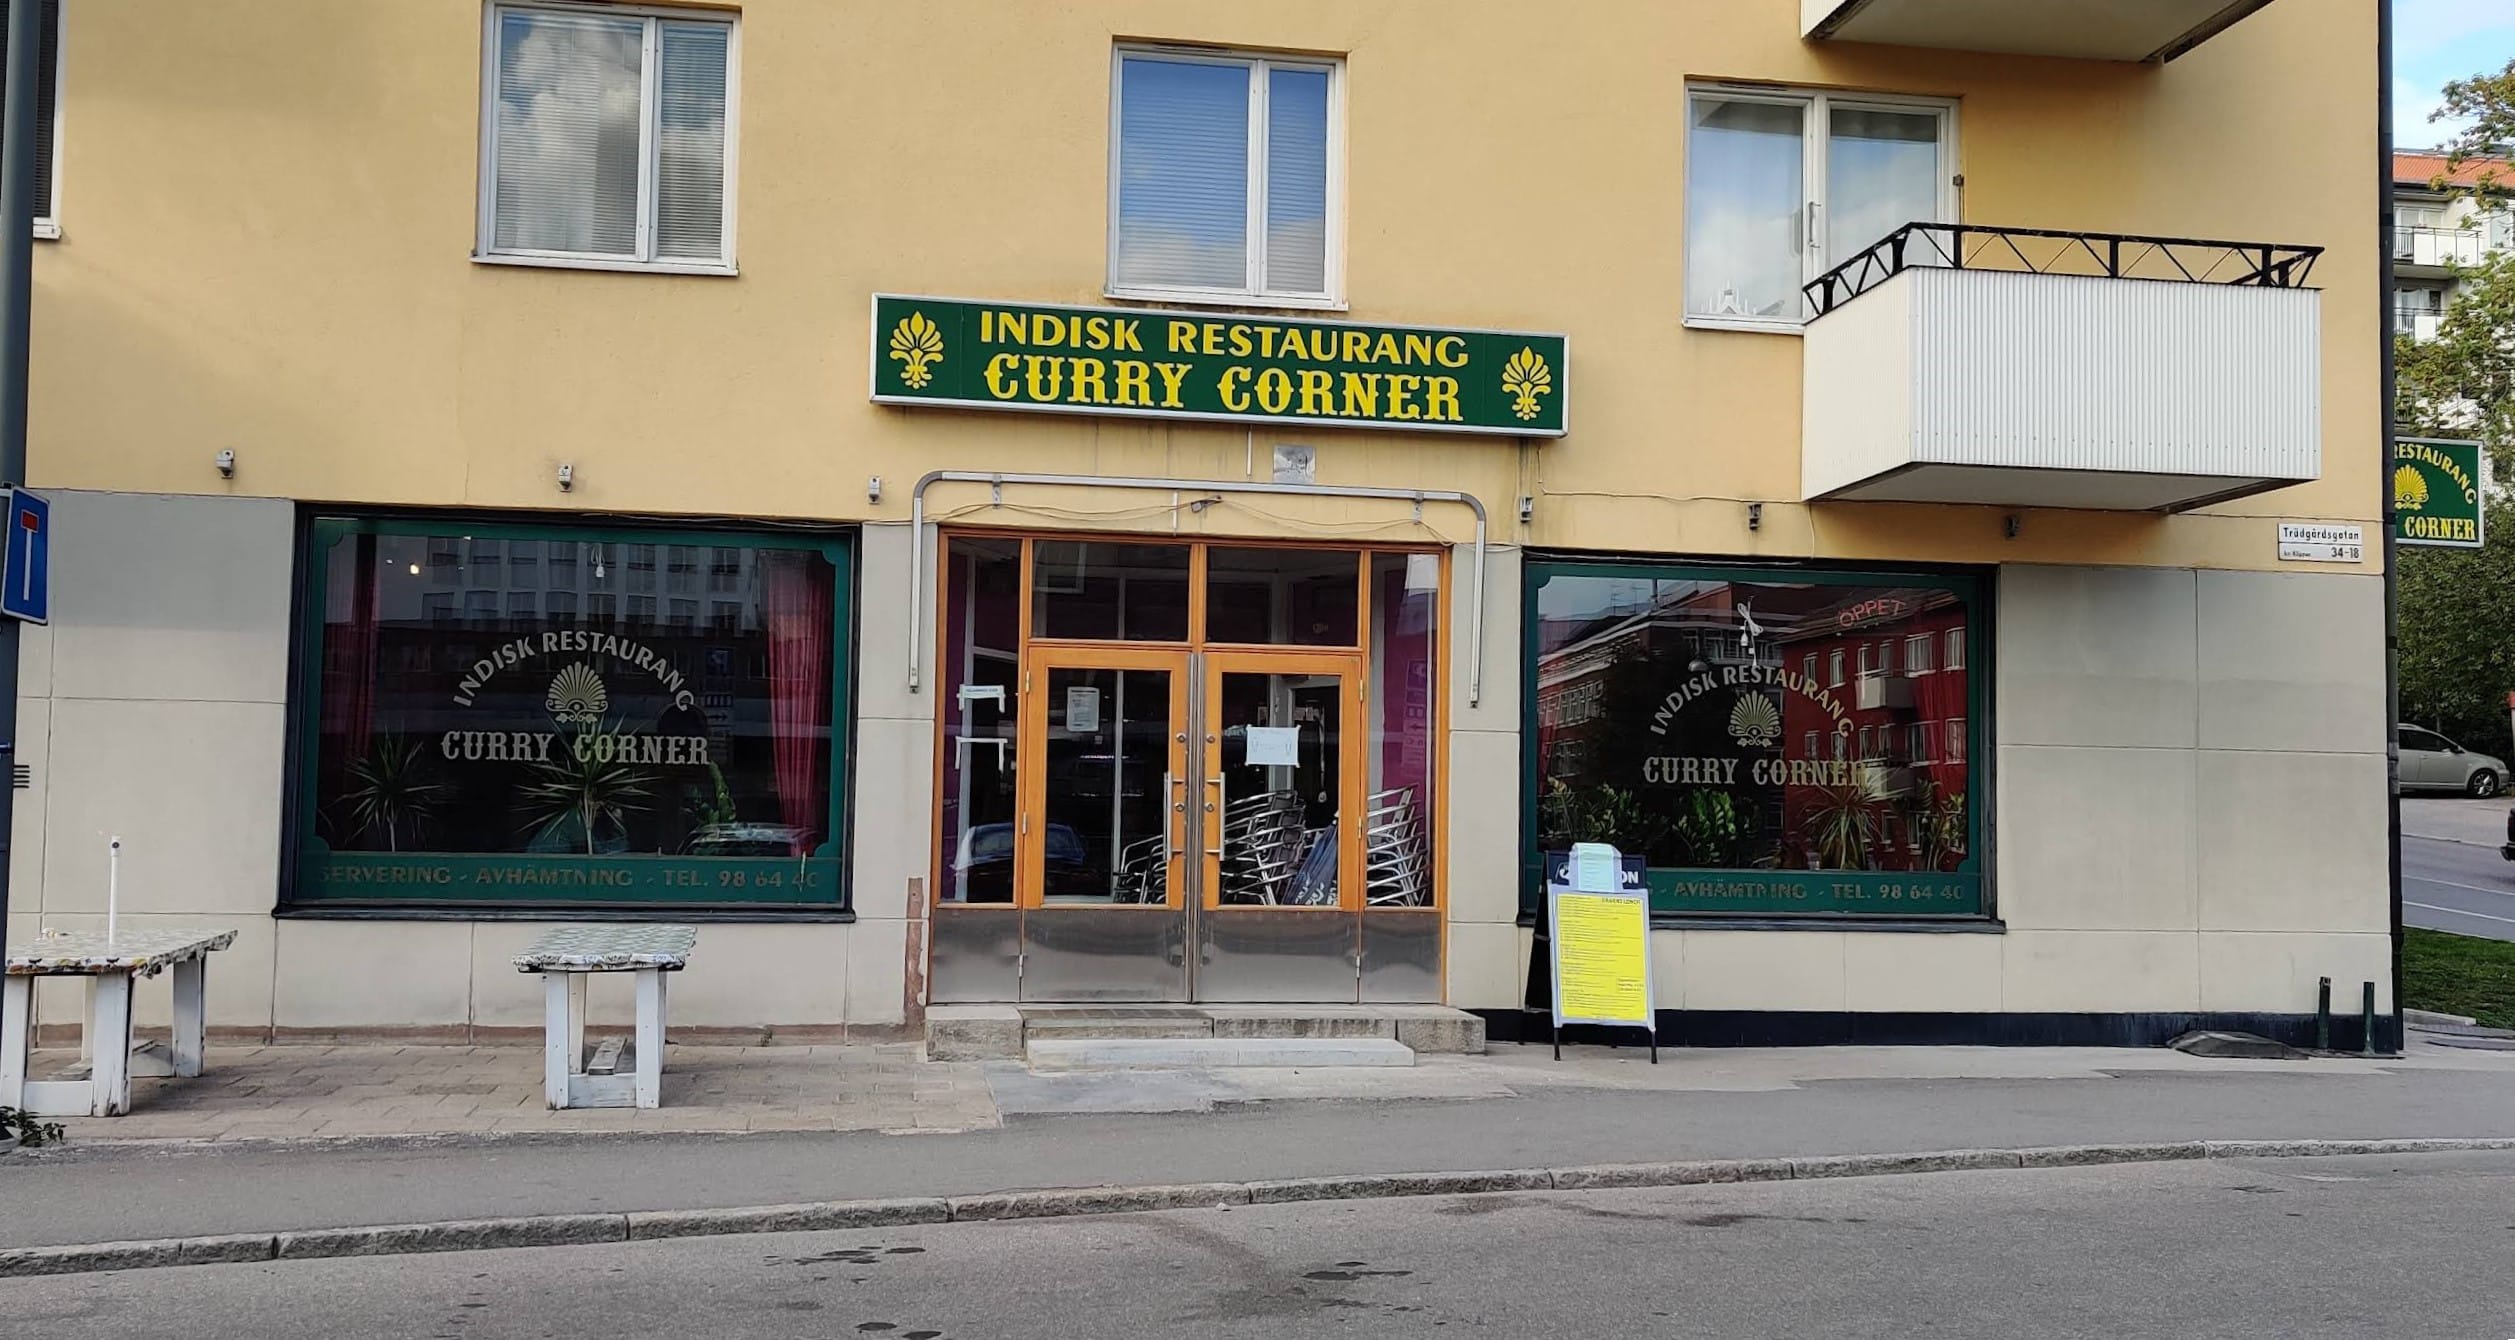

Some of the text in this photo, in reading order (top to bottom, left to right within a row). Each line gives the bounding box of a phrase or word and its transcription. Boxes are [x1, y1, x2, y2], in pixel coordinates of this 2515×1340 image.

[980, 310, 1469, 368] INDISK RESTAURANG
[983, 352, 1463, 422] CURRY CORNER
[2283, 527, 2359, 542] Trädgårdsgatan
[2404, 516, 2476, 540] CORNER
[2331, 547, 2360, 559] 34-18
[453, 630, 695, 712] INDISK RESTAURANG
[1650, 665, 1854, 738] INDISK RESTAURANG
[440, 730, 710, 765] CURRY CORNER
[1643, 756, 1740, 785] CURRY
[662, 869, 709, 887] TEL.
[719, 870, 746, 888] 98
[755, 871, 783, 887] 64
[1831, 883, 1871, 899] TEL.
[1879, 883, 1902, 899] 98
[1909, 884, 1933, 899] 64
